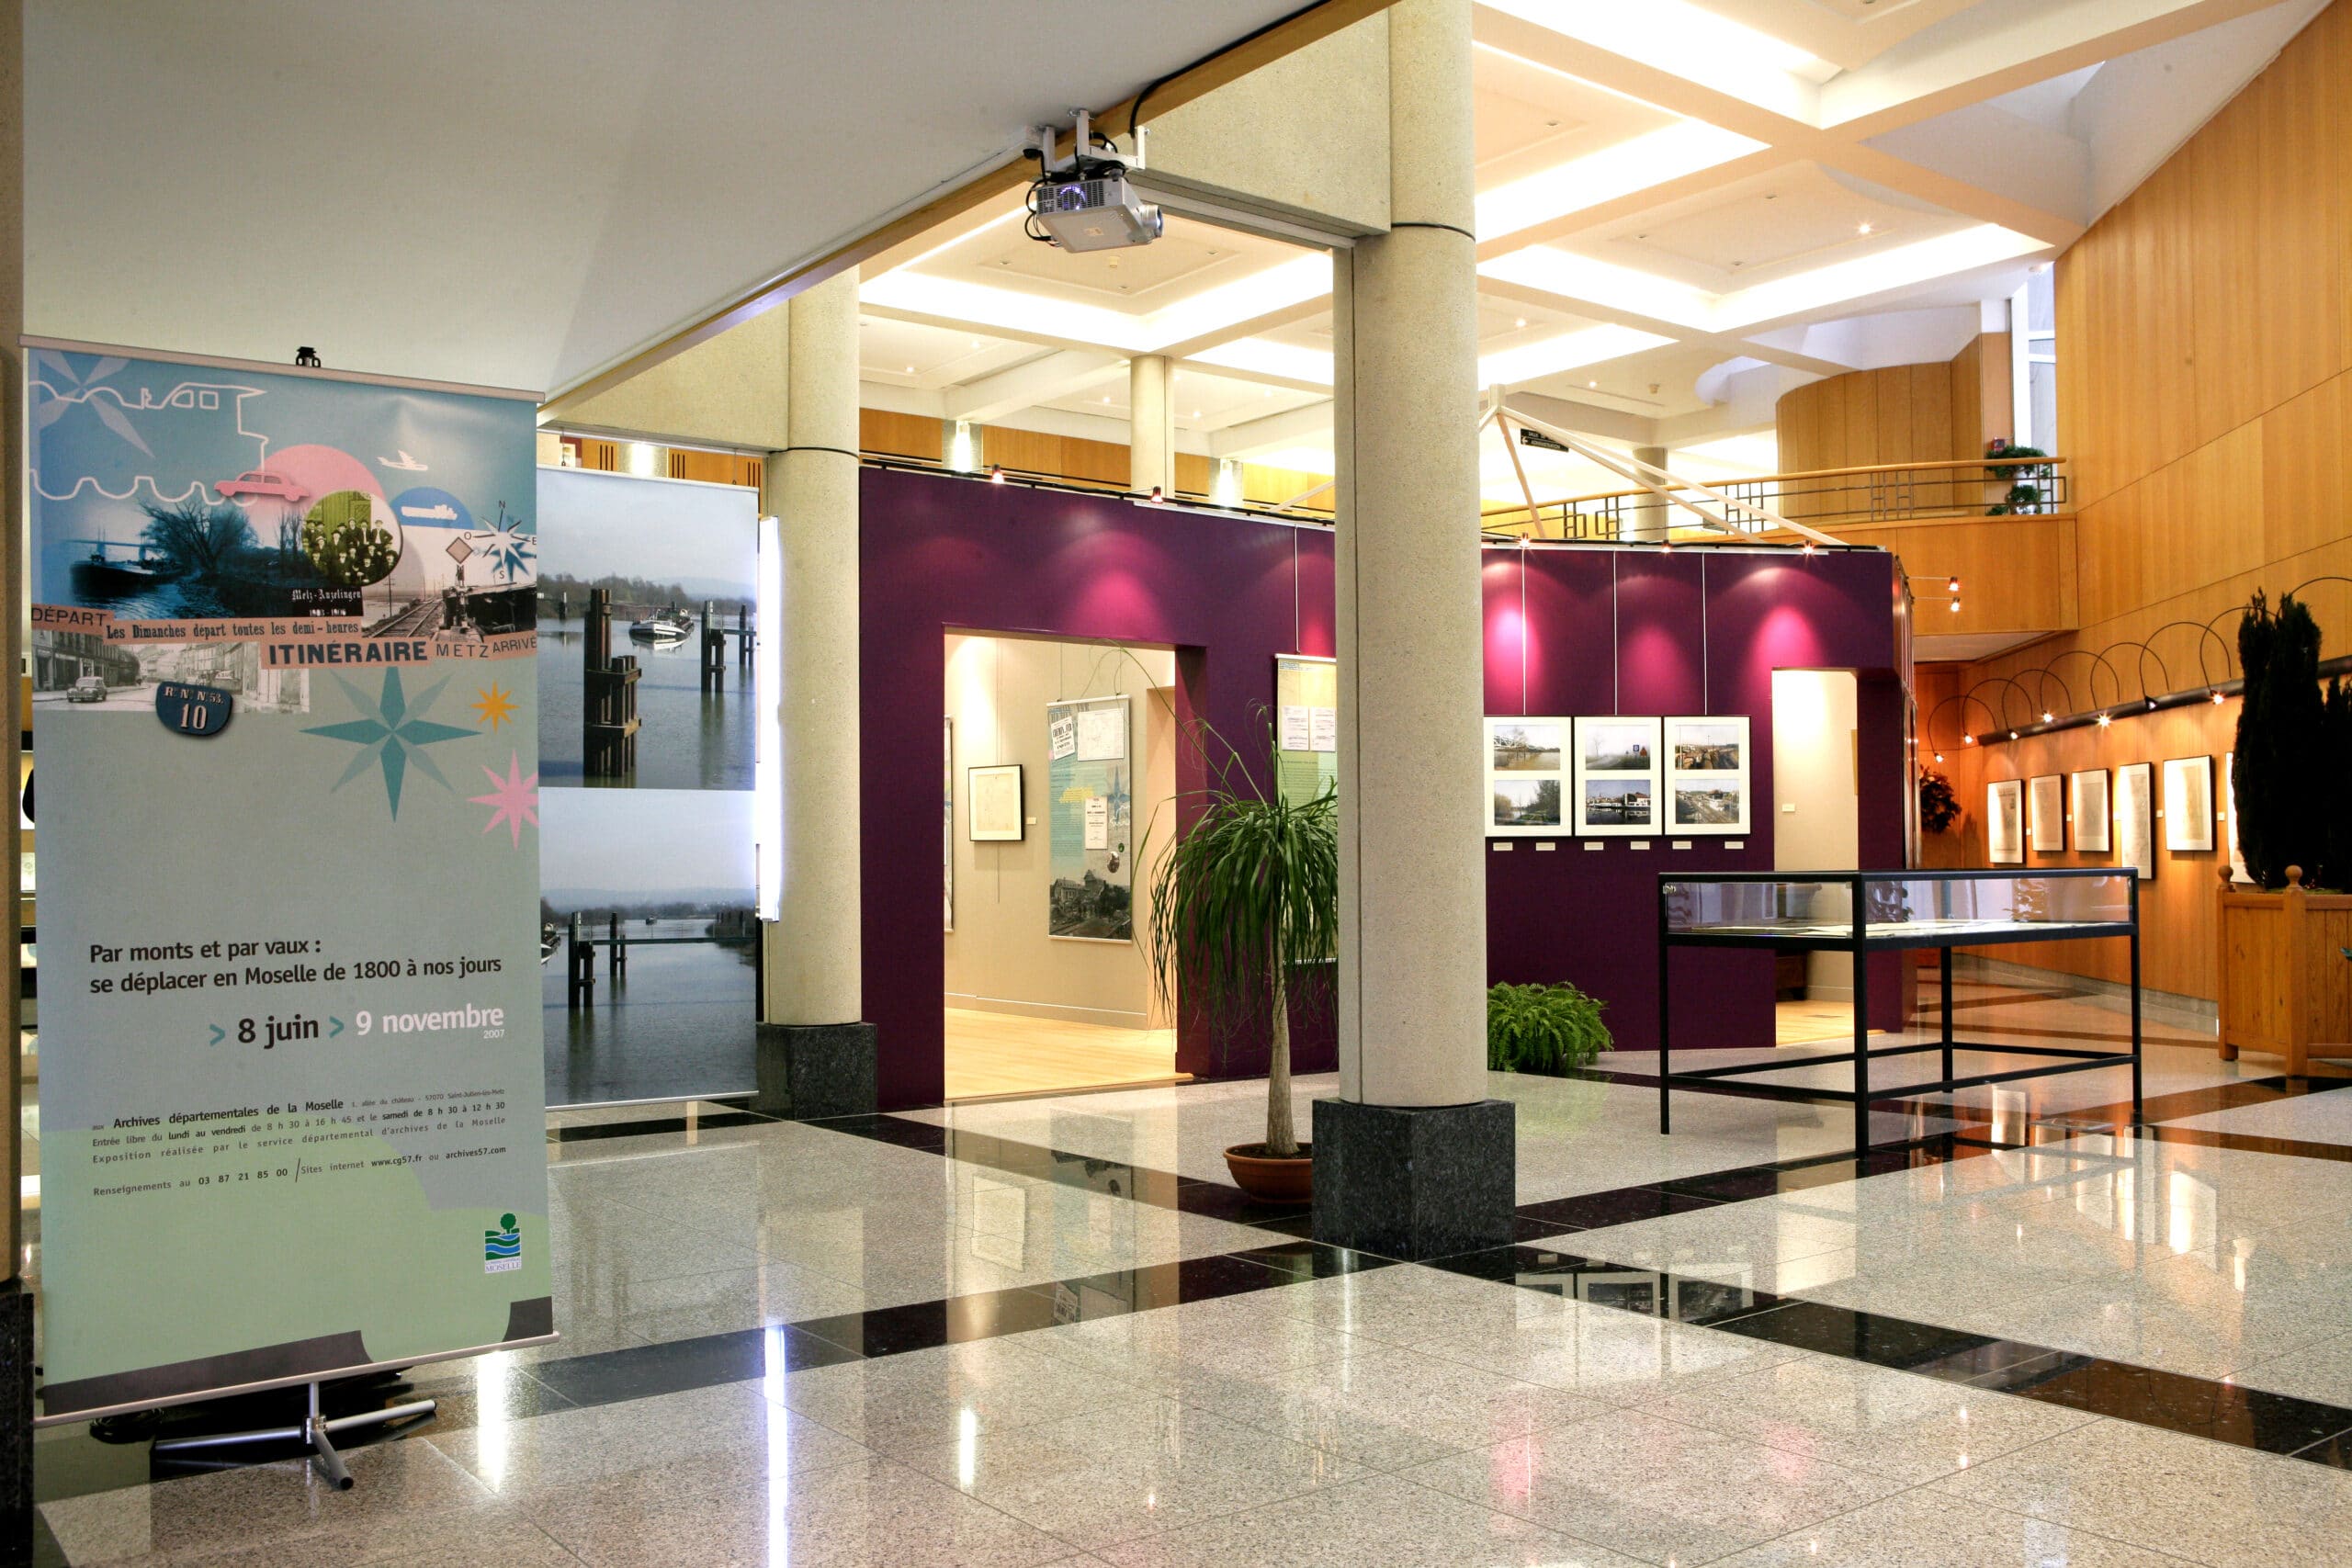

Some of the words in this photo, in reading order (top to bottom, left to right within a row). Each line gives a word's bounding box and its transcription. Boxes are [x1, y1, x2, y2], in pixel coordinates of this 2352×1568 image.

[499, 501, 505, 509] N
[500, 570, 505, 579] S
[31, 606, 107, 626] DÉPART
[106, 625, 125, 639] Les
[132, 625, 186, 639] Dimanches
[193, 623, 226, 640] départ
[233, 622, 265, 636] toutes
[271, 622, 286, 635] les
[269, 639, 428, 665] ITINÉRAIRE
[436, 643, 489, 658] METZ
[180, 704, 207, 729] 10
[90, 944, 123, 963] Par
[130, 942, 193, 961] monts
[200, 941, 221, 957] et
[228, 942, 259, 961] par
[265, 941, 309, 955] vaux
[90, 979, 113, 994] se
[120, 972, 208, 995] déplacer
[213, 974, 237, 987] en
[245, 964, 316, 985] Moselle
[323, 963, 345, 981] de
[353, 961, 401, 979] 1800
[406, 959, 417, 976] à
[424, 961, 454, 976] nos
[458, 956, 502, 979] jours
[237, 1018, 255, 1043] 8
[264, 1014, 319, 1049] juin
[356, 1010, 372, 1036] 9
[382, 1003, 503, 1033] novembre
[483, 1029, 505, 1039] 2007
[93, 1137, 120, 1146] Entrée
[127, 1135, 145, 1145] libre
[152, 1134, 162, 1142] du
[169, 1131, 189, 1140] lundi
[211, 1125, 246, 1135] vendredi
[266, 1122, 272, 1131] 8
[288, 1121, 300, 1129] 30
[342, 1115, 351, 1124] 45
[382, 1110, 408, 1121] samedi
[448, 1106, 458, 1114] 30
[114, 1116, 160, 1128] Archives
[169, 1107, 259, 1125] départementales
[266, 1104, 279, 1115] de
[288, 1103, 298, 1113] la
[305, 1100, 344, 1111] Moselle
[93, 1151, 151, 1164] Exposition
[162, 1146, 204, 1157] réalisée
[213, 1145, 230, 1154] par
[239, 1141, 248, 1150] le
[257, 1137, 293, 1147] service
[301, 1130, 373, 1144] départemental
[456, 1121, 464, 1129] la
[472, 1117, 505, 1126] Moselle
[301, 1165, 323, 1174] Sites
[330, 1161, 364, 1171] internet
[371, 1154, 423, 1167] www.cg57.fr
[445, 1146, 506, 1159] archives57.com
[94, 1180, 172, 1196] Renseignements
[198, 1177, 209, 1185] 03
[219, 1174, 230, 1183] 87
[238, 1172, 249, 1181] 21
[257, 1170, 268, 1179] 85
[276, 1168, 288, 1177] 00
